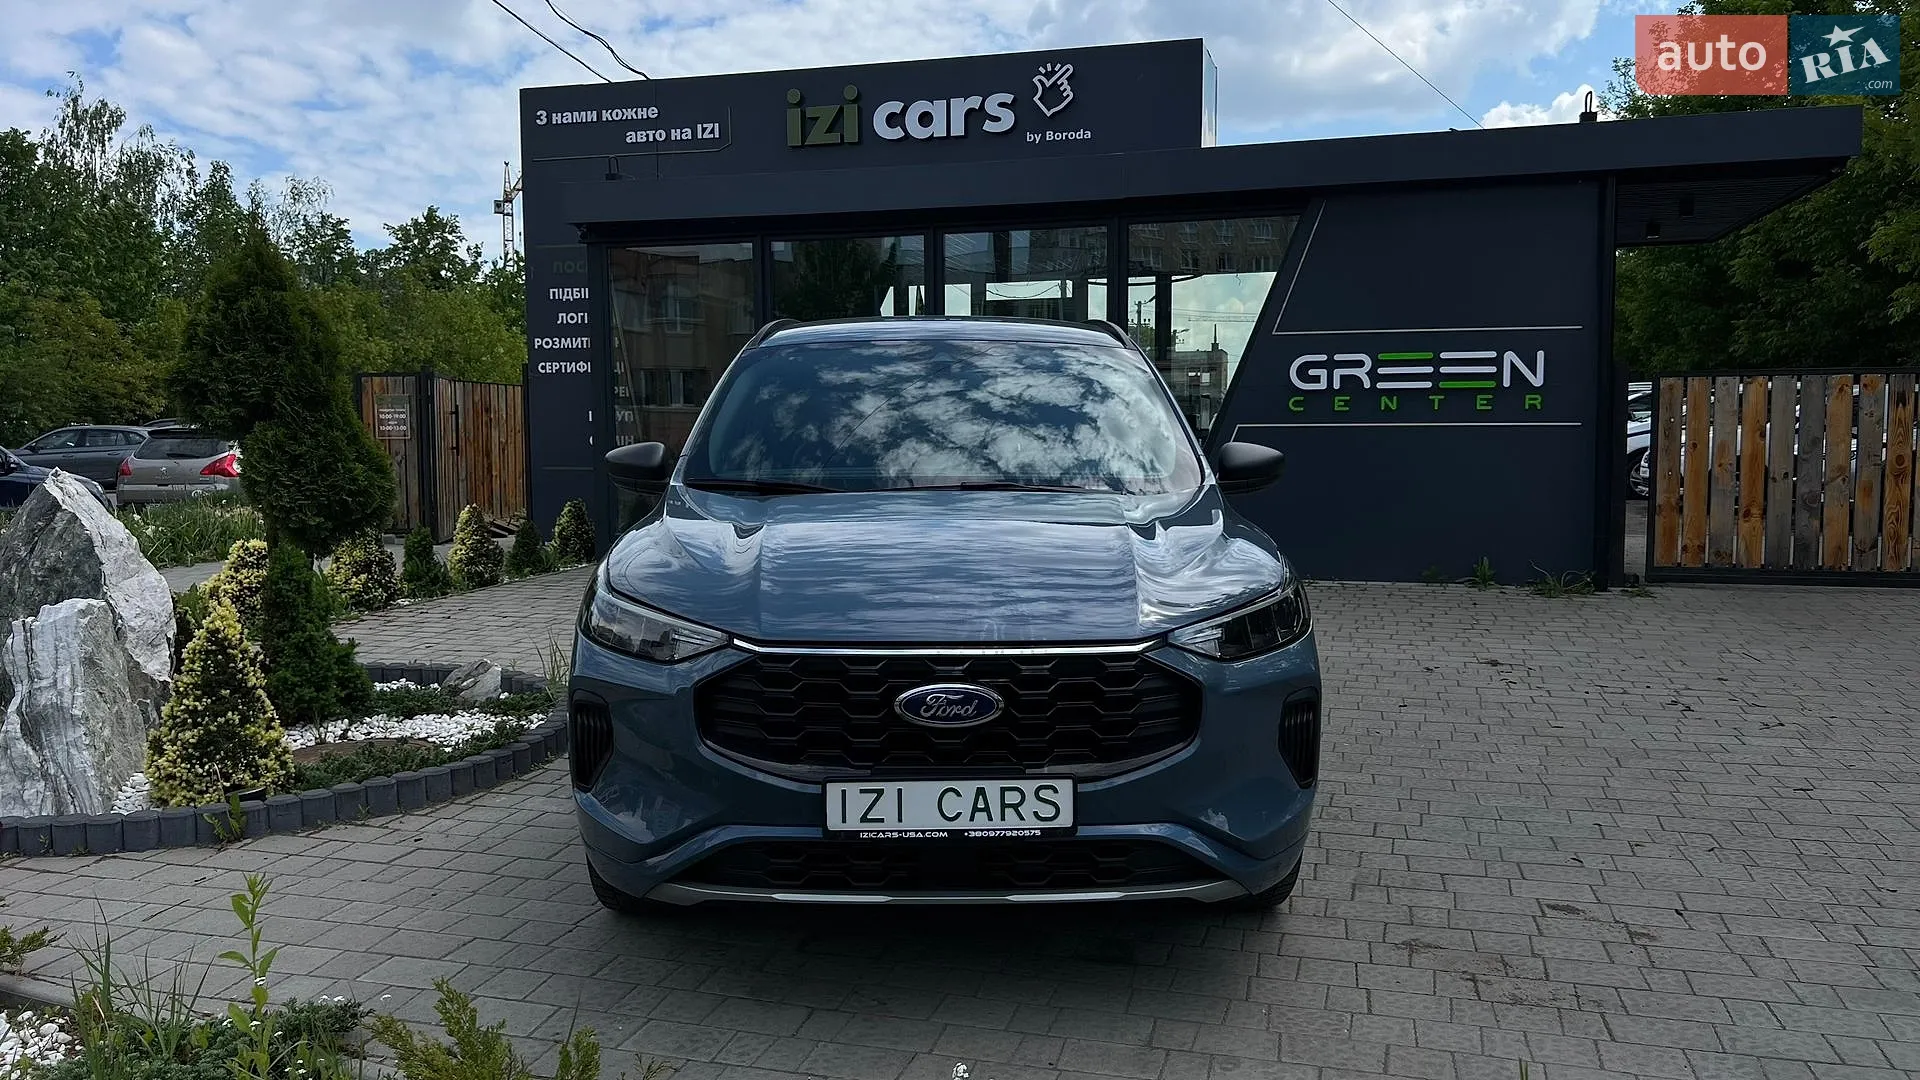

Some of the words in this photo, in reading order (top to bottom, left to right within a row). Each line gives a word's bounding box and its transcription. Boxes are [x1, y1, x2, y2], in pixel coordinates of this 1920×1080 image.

[552, 110, 598, 125] нами
[601, 106, 659, 122] кожне
[786, 84, 861, 147] izi
[873, 92, 1016, 140] cars
[625, 130, 667, 144] авто
[670, 127, 692, 141] на
[697, 122, 720, 139] IZI
[1026, 131, 1041, 144] by
[1046, 128, 1091, 141] Boroda
[1289, 350, 1545, 390] GREEN
[1288, 394, 1543, 411] CENTER
[919, 693, 979, 718] Ford
[841, 787, 904, 824] IZI
[937, 784, 1061, 823] CARS
